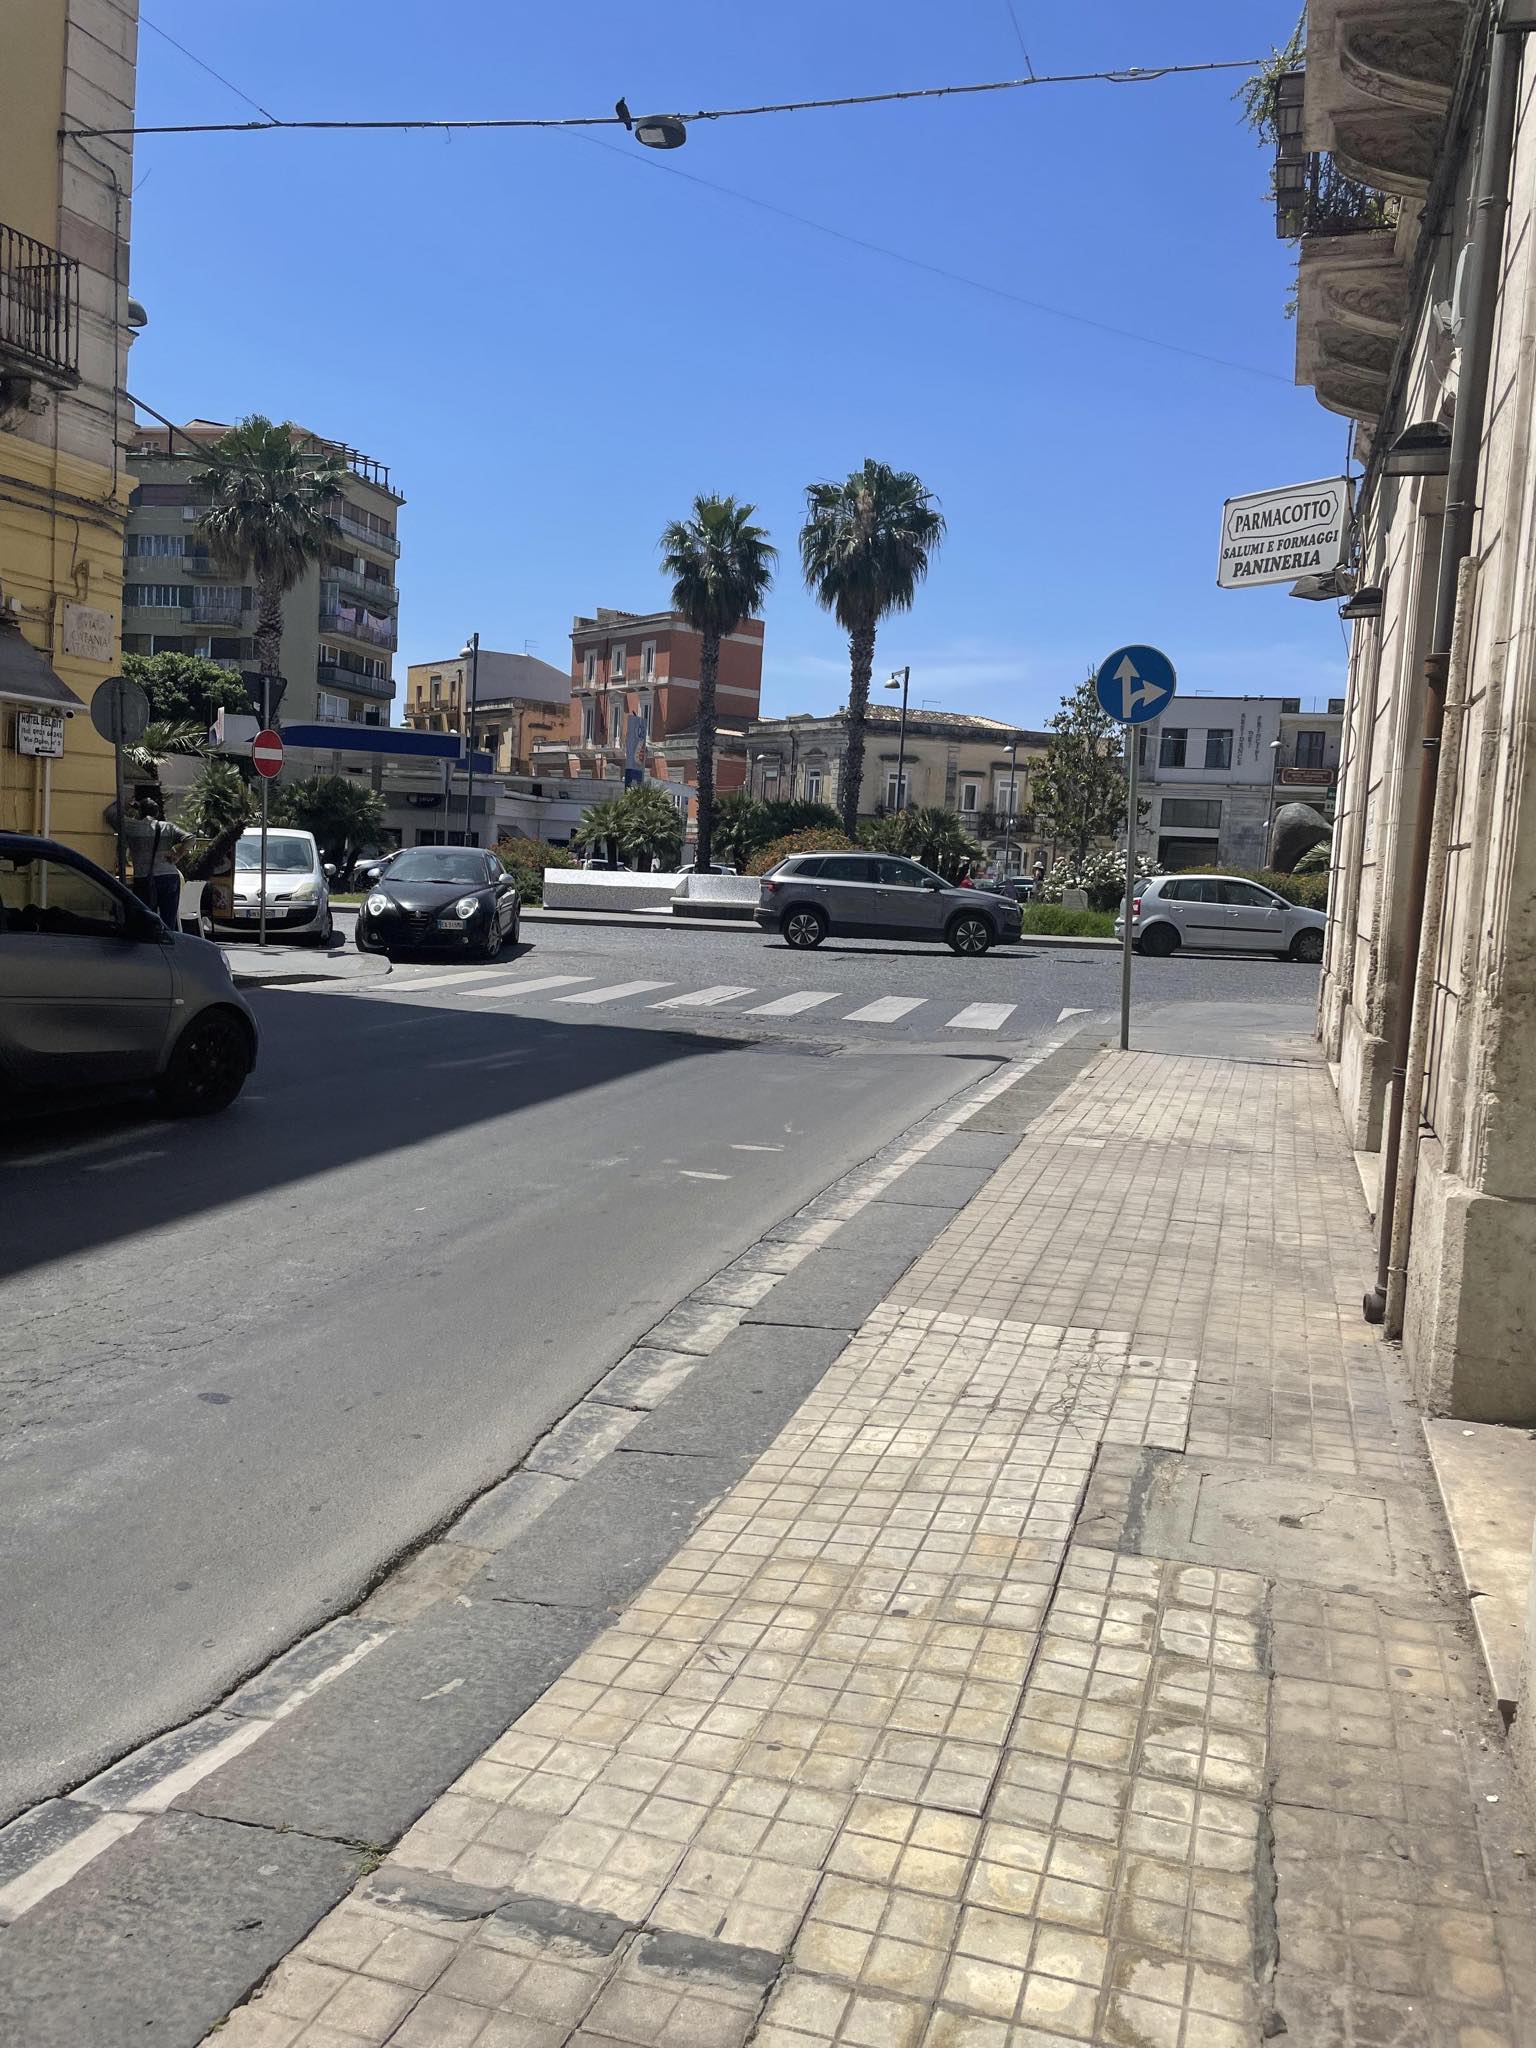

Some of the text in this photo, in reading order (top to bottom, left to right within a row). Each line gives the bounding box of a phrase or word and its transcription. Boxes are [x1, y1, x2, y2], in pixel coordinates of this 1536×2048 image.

[1235, 499, 1331, 533] PARMACOTTO
[1223, 529, 1339, 559] SALUMI E FORMAGGI
[1232, 549, 1321, 578] PANINERIA
[21, 714, 40, 725] HOTEL
